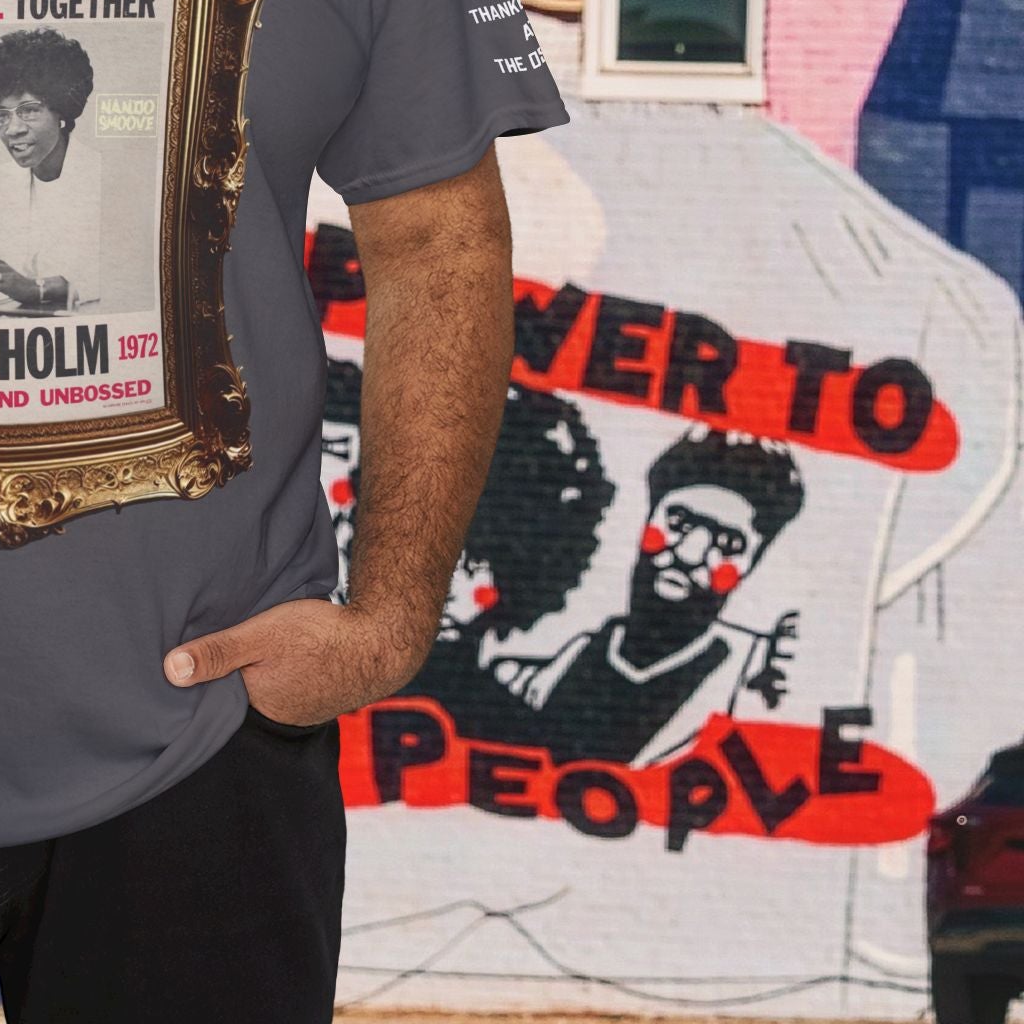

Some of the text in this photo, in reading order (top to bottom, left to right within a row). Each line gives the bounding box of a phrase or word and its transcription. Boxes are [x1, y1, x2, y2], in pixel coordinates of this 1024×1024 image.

[522, 20, 536, 41] A
[494, 56, 527, 74] THE
[118, 333, 159, 361] 1972
[40, 379, 152, 407] UNBOSSED
[786, 340, 934, 455] TO
[369, 707, 882, 853] PEOPLE
